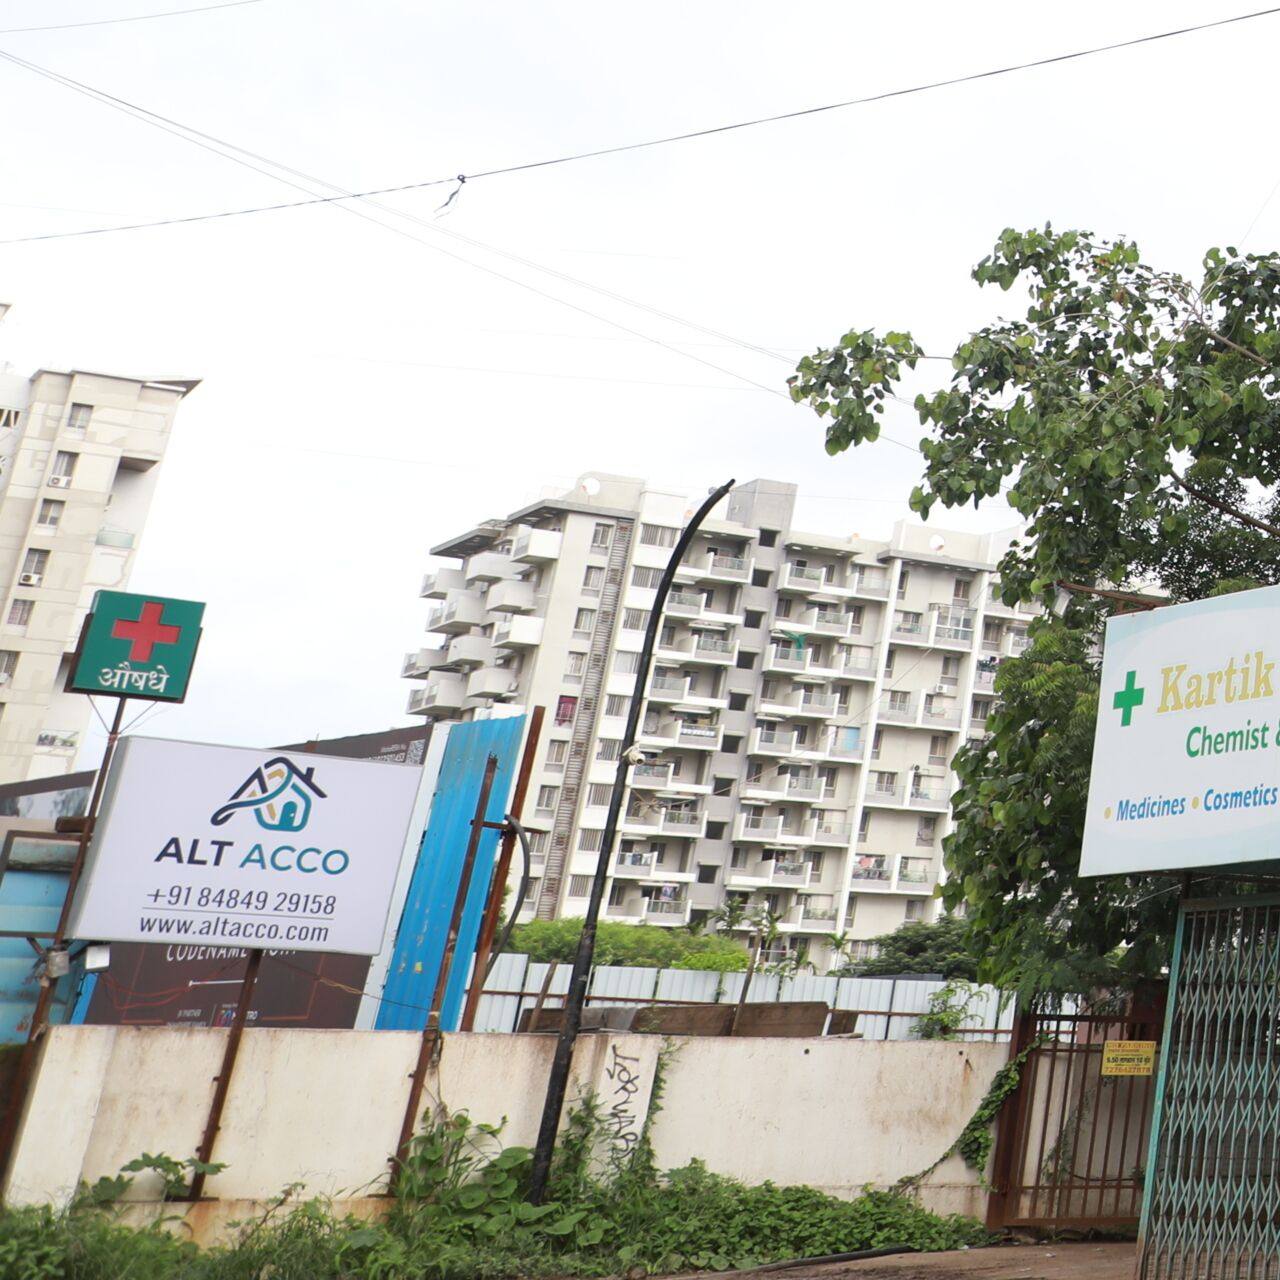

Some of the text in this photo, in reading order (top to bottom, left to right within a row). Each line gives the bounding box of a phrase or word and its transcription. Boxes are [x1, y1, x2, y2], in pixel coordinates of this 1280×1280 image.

[99, 662, 169, 693] औषधे
[1157, 650, 1275, 714] Kartik
[1186, 719, 1270, 758] Chemist
[1116, 795, 1186, 821] Medicines
[1203, 784, 1278, 812] Cosmetics
[155, 837, 350, 875] ALT ACCO
[147, 885, 337, 915] +91 84849 29158
[140, 915, 329, 943] www.altacco.com
